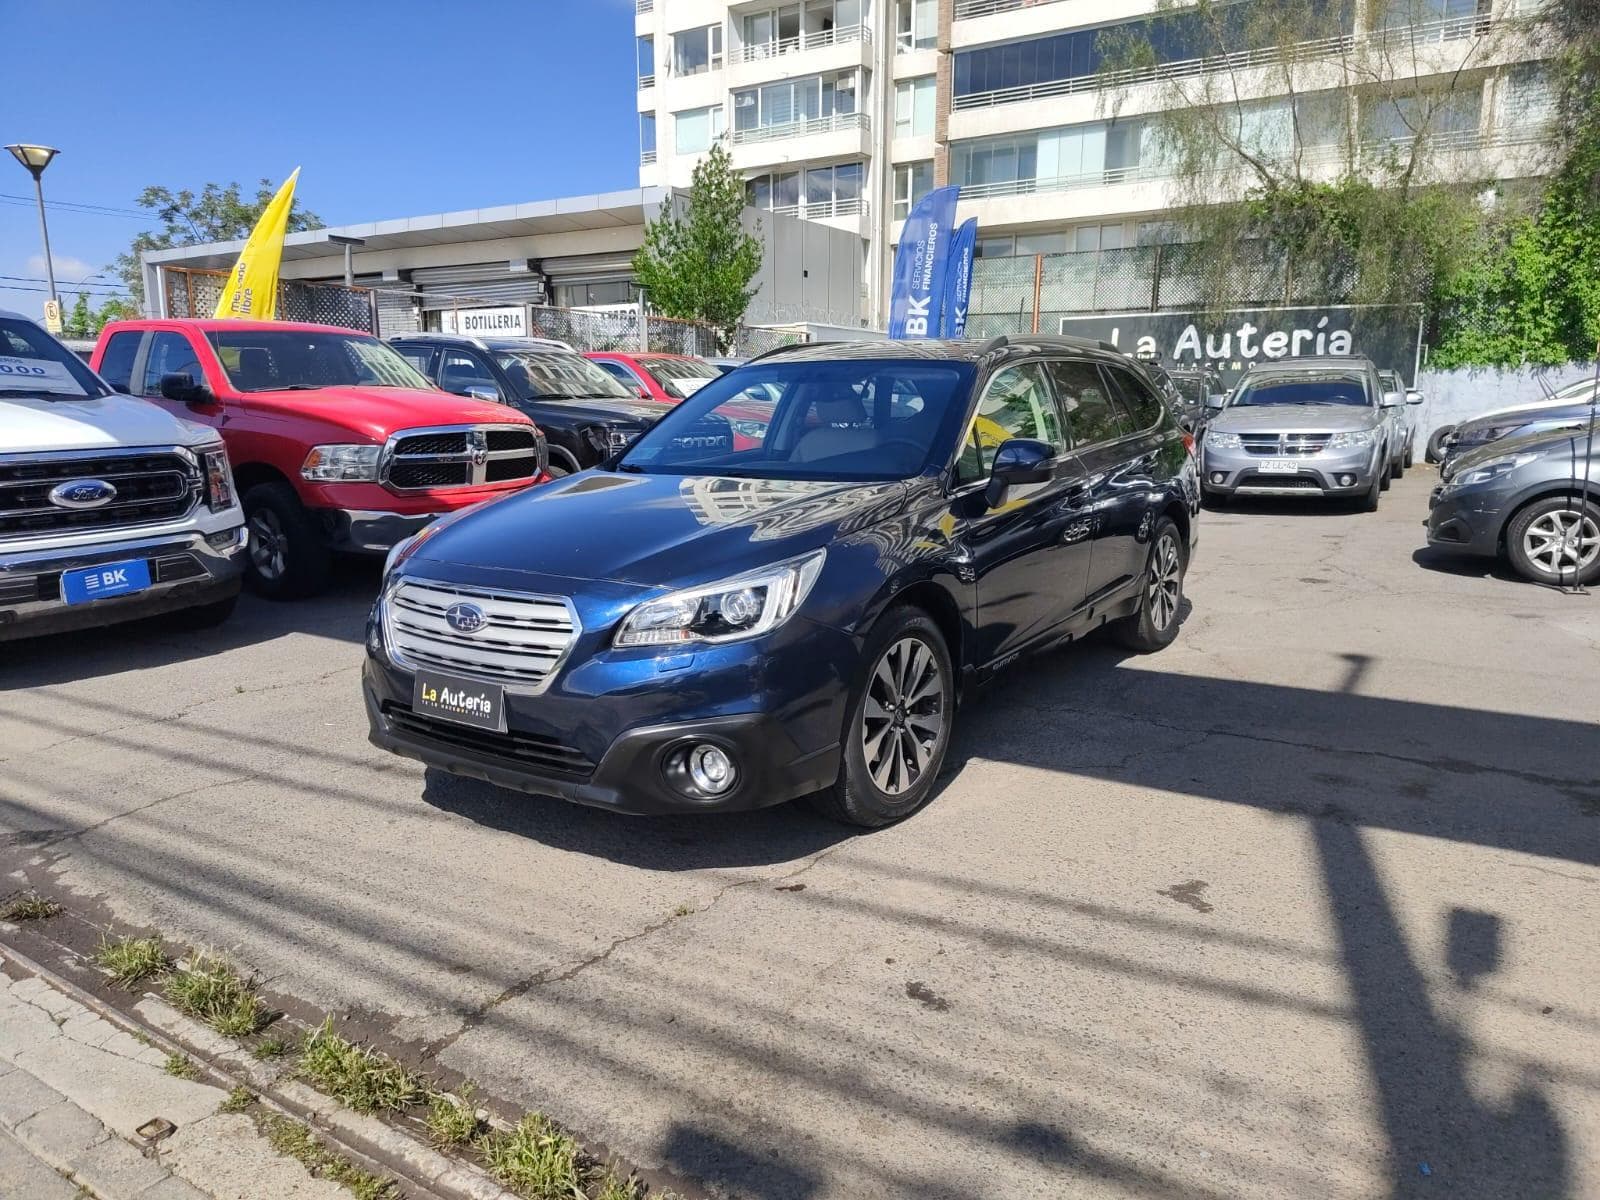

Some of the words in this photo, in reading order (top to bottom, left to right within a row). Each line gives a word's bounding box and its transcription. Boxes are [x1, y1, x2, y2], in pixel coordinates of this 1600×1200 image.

[912, 240, 926, 290] SERVICIOS
[922, 223, 938, 290] FINANCIEROS
[240, 288, 253, 314] libre
[905, 295, 931, 336] BK
[465, 314, 521, 330] BOTILLERIA
[955, 306, 967, 337] BK
[1173, 316, 1352, 360] Autería
[72, 487, 102, 501] Ford
[102, 568, 128, 586] BK
[422, 682, 437, 702] La
[440, 686, 492, 714] Autería
